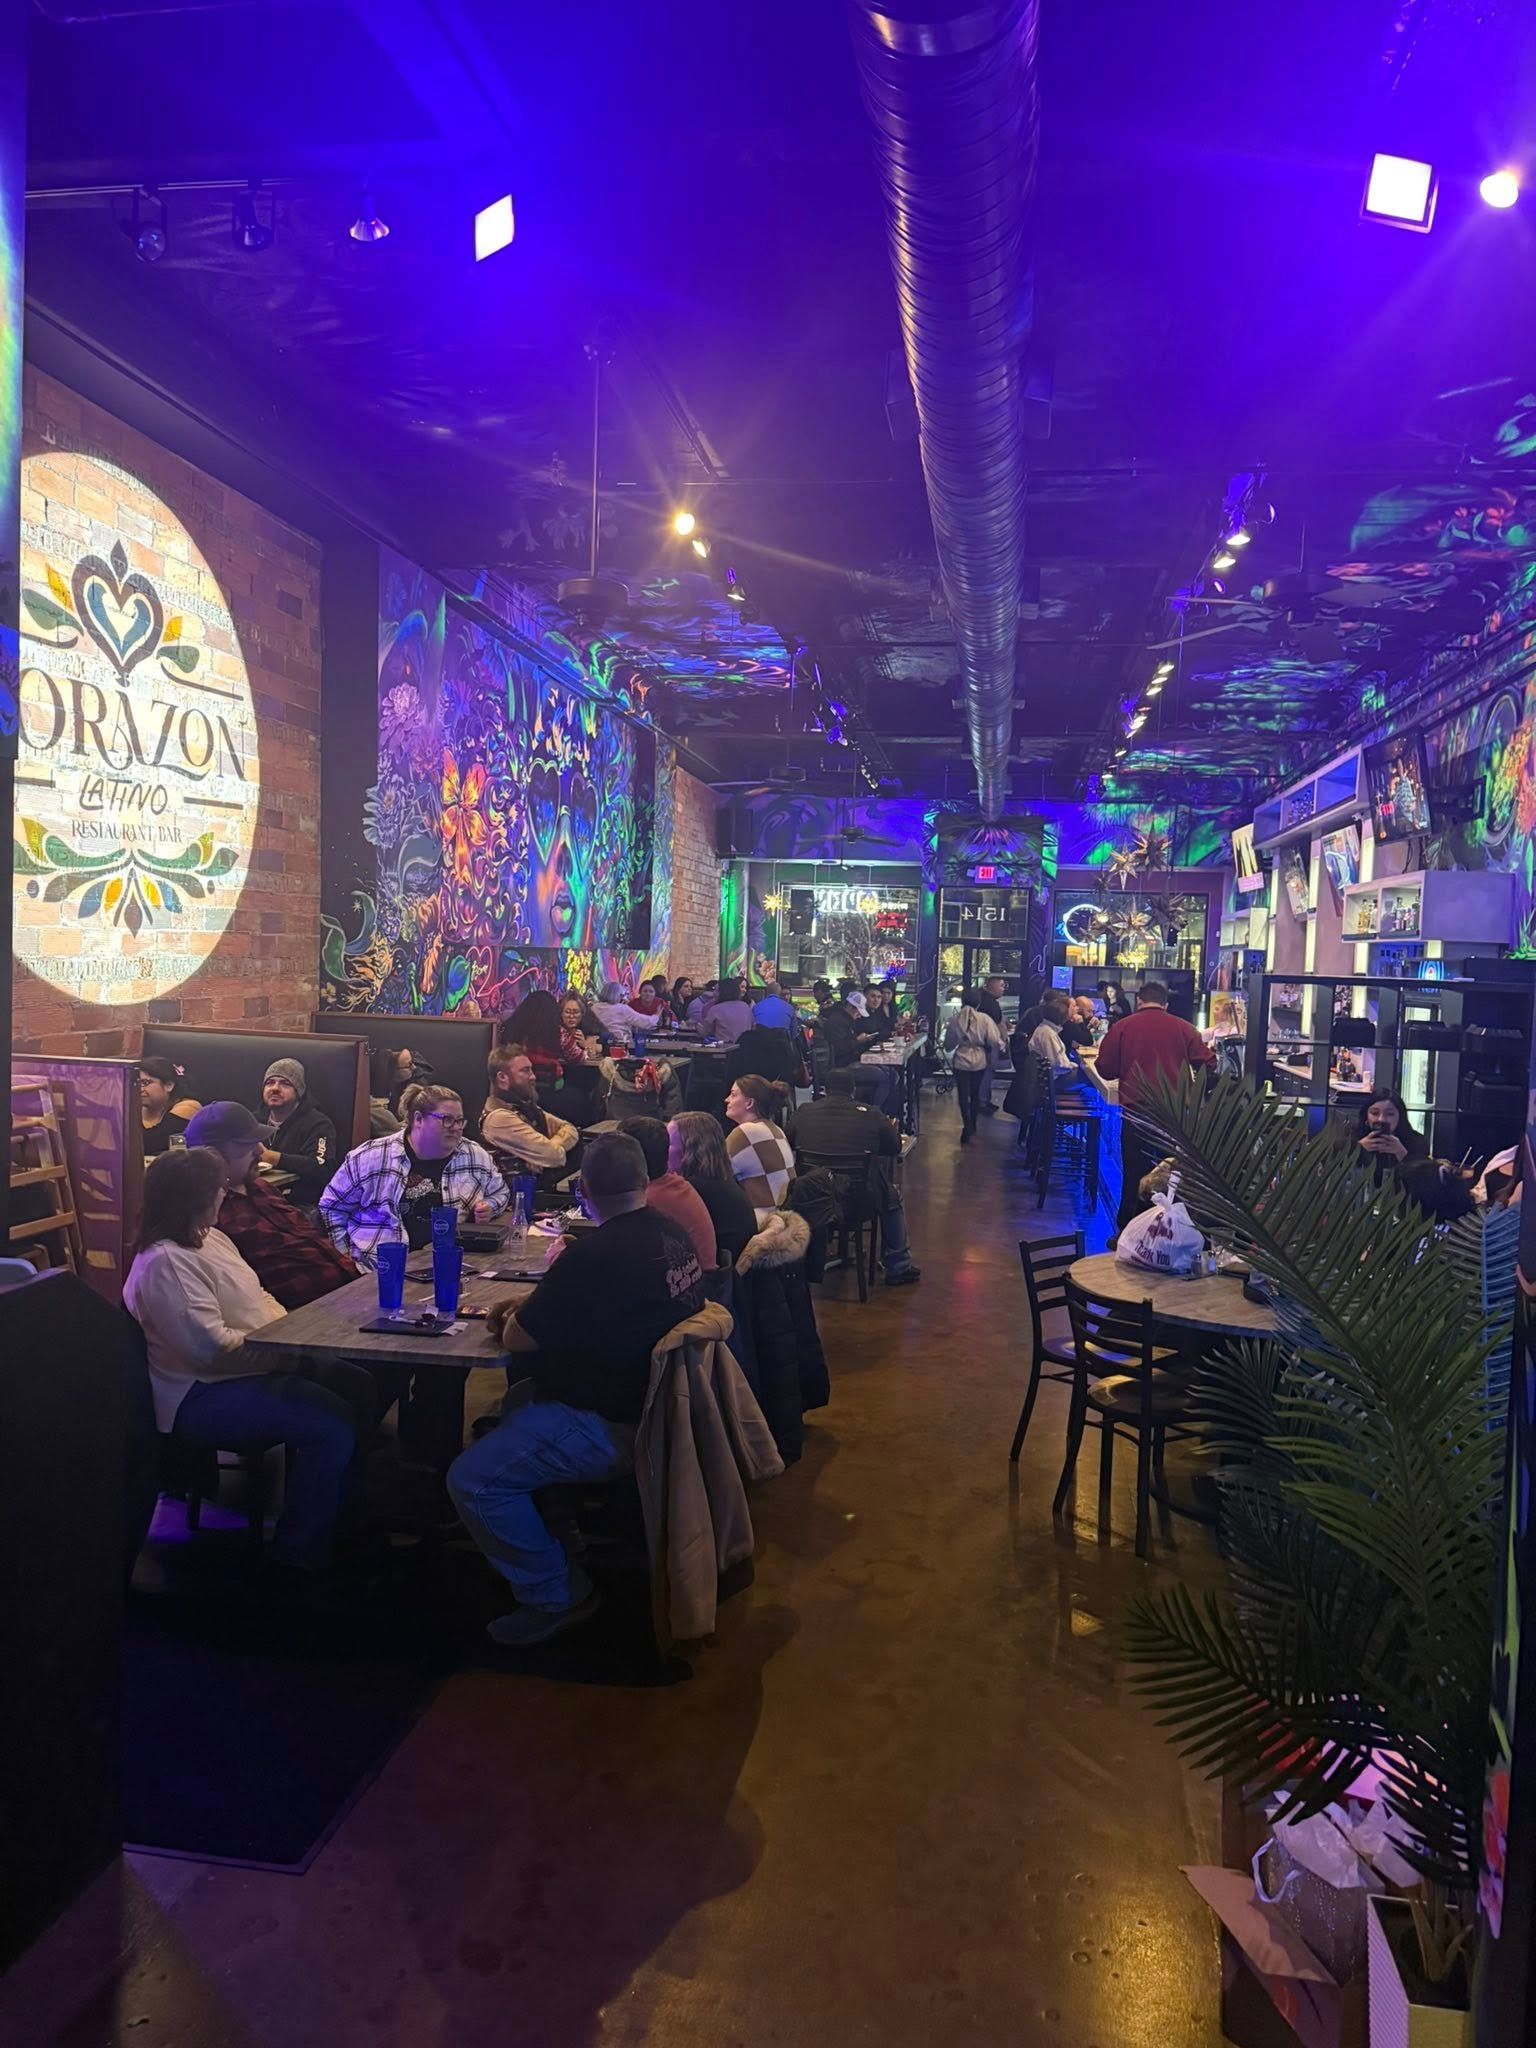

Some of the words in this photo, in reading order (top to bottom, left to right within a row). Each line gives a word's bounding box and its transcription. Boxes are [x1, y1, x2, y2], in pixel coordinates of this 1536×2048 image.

[79, 774, 168, 815] LATINO
[71, 819, 153, 843] RESTAURANT
[158, 826, 183, 844] BAR
[978, 866, 995, 879] EXIT
